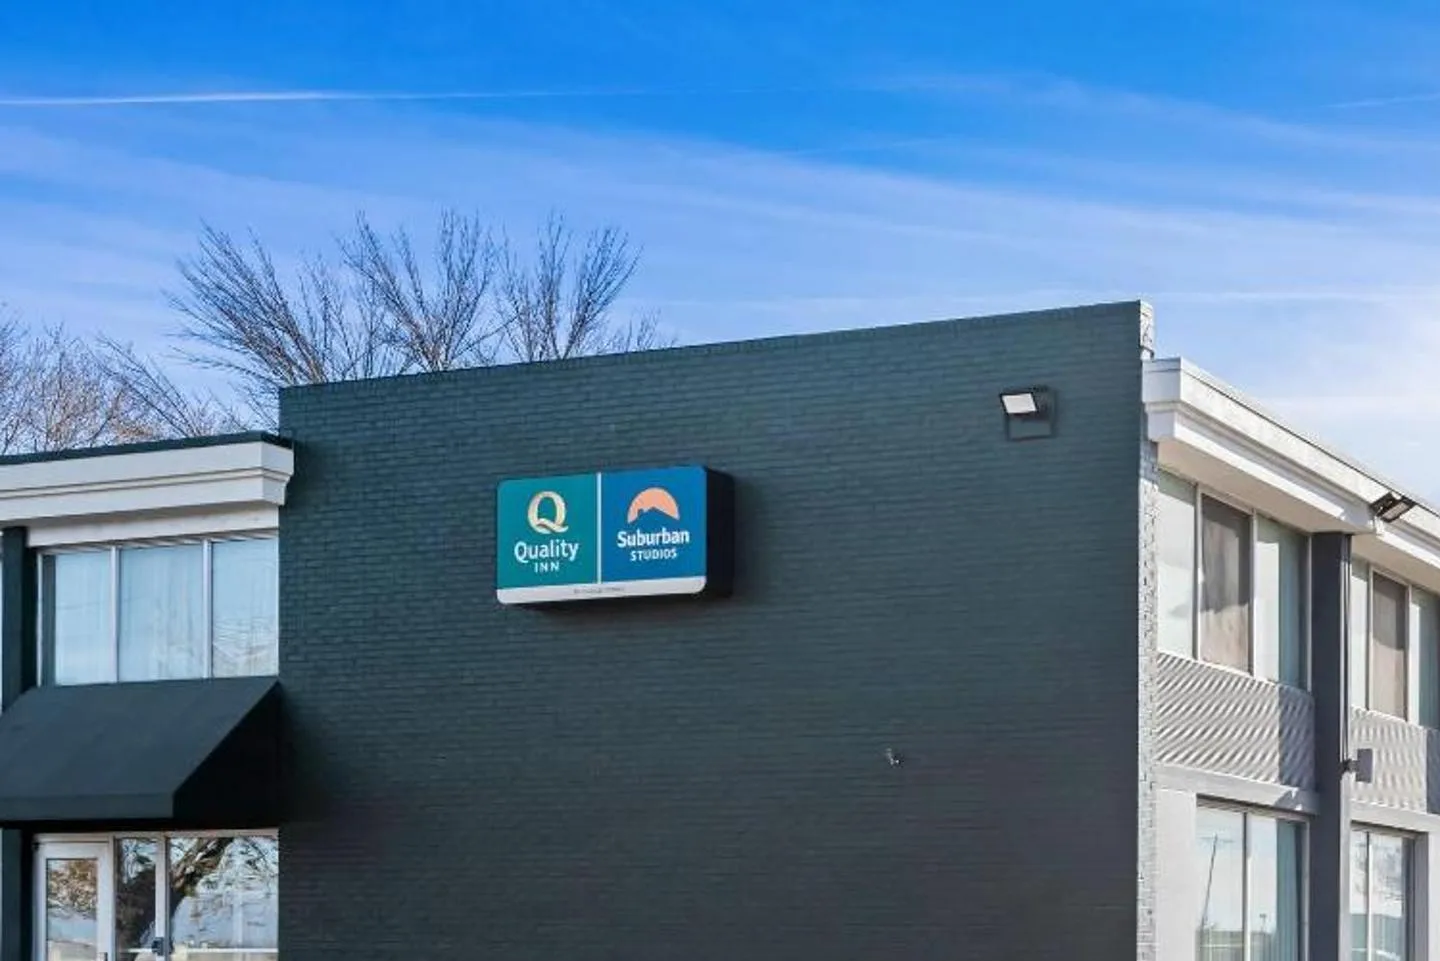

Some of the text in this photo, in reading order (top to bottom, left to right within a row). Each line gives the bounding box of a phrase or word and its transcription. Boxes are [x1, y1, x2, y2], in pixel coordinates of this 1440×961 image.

[528, 491, 568, 534] Q
[617, 528, 690, 547] Suburban
[514, 539, 579, 562] Quality
[631, 549, 677, 561] STUDIOS
[534, 562, 559, 573] INN
